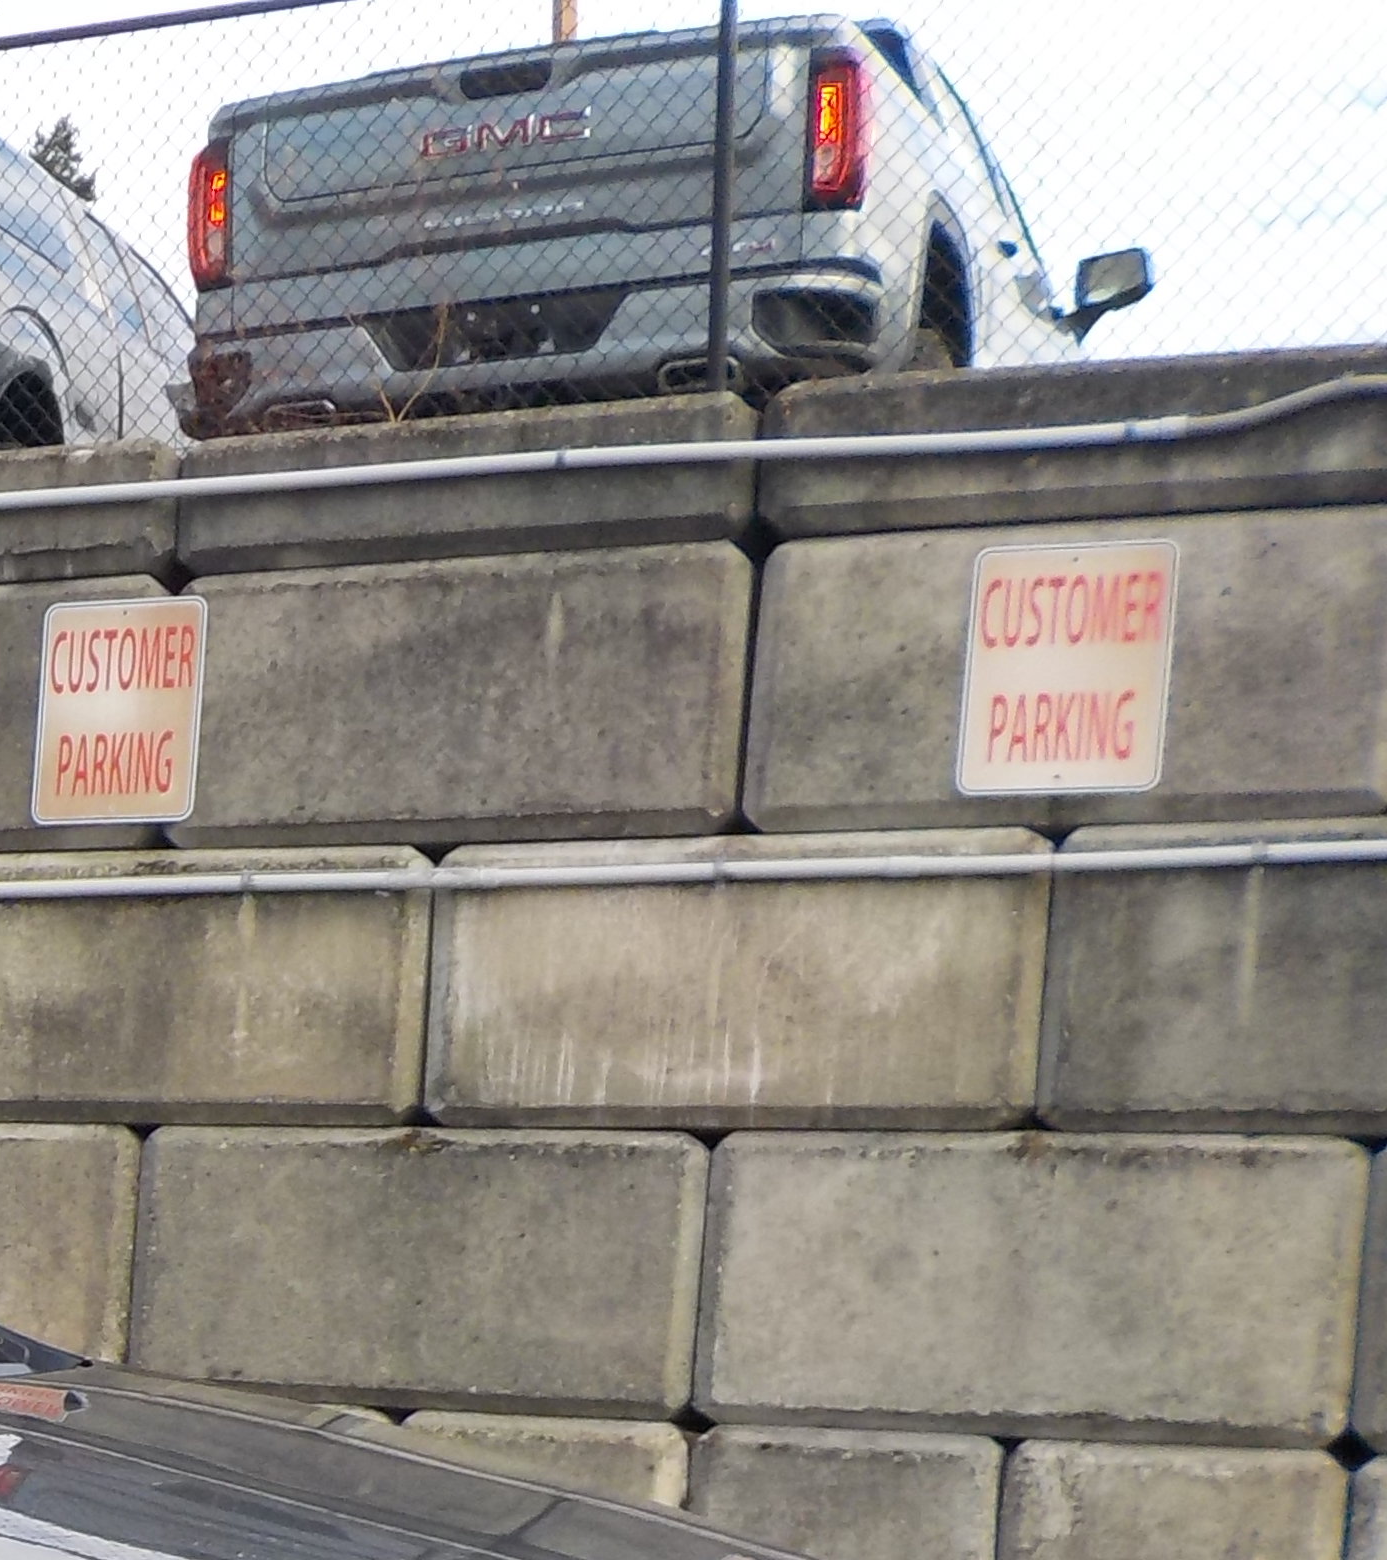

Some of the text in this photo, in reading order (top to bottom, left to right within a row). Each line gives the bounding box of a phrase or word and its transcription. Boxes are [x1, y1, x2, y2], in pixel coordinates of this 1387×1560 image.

[419, 105, 592, 160] GMC
[980, 571, 1165, 649] CUSTOMER
[50, 624, 196, 694] CUSTOMER
[986, 689, 1136, 763] PARKING
[55, 730, 175, 796] PARKING
